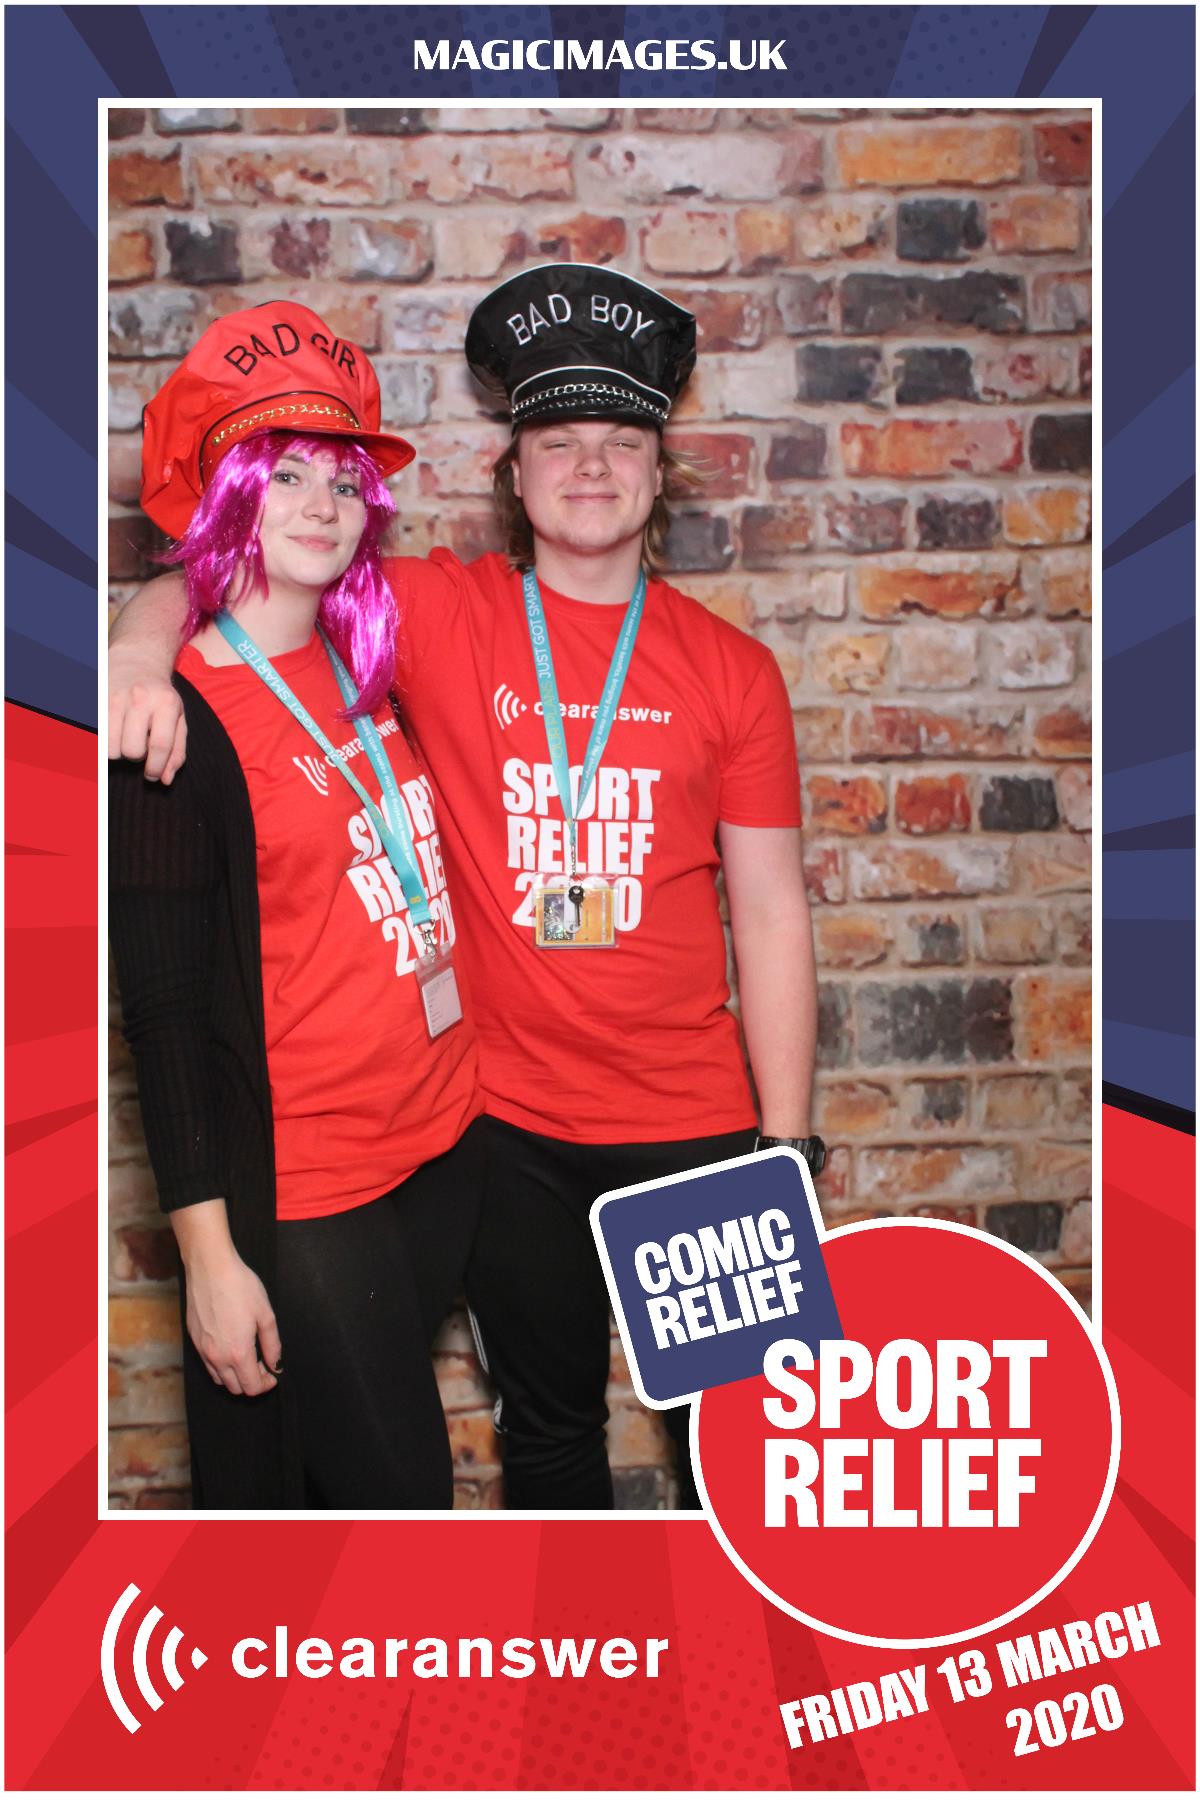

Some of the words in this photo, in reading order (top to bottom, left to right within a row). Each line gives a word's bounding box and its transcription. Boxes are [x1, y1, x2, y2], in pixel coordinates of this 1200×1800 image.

[506, 294, 572, 346] BAD
[591, 294, 656, 340] BOY
[223, 323, 300, 376] BAD
[310, 332, 357, 379] GIR
[522, 571, 541, 616] SMART
[530, 620, 545, 644] GOT
[237, 639, 292, 702] SMARTER
[535, 649, 551, 679] JUST
[287, 697, 315, 731] GOT
[534, 701, 672, 724] cearaswer
[308, 727, 341, 762] JUST
[502, 757, 662, 821] SPORT
[507, 815, 655, 876] RELIEF
[512, 872, 643, 932] 20
